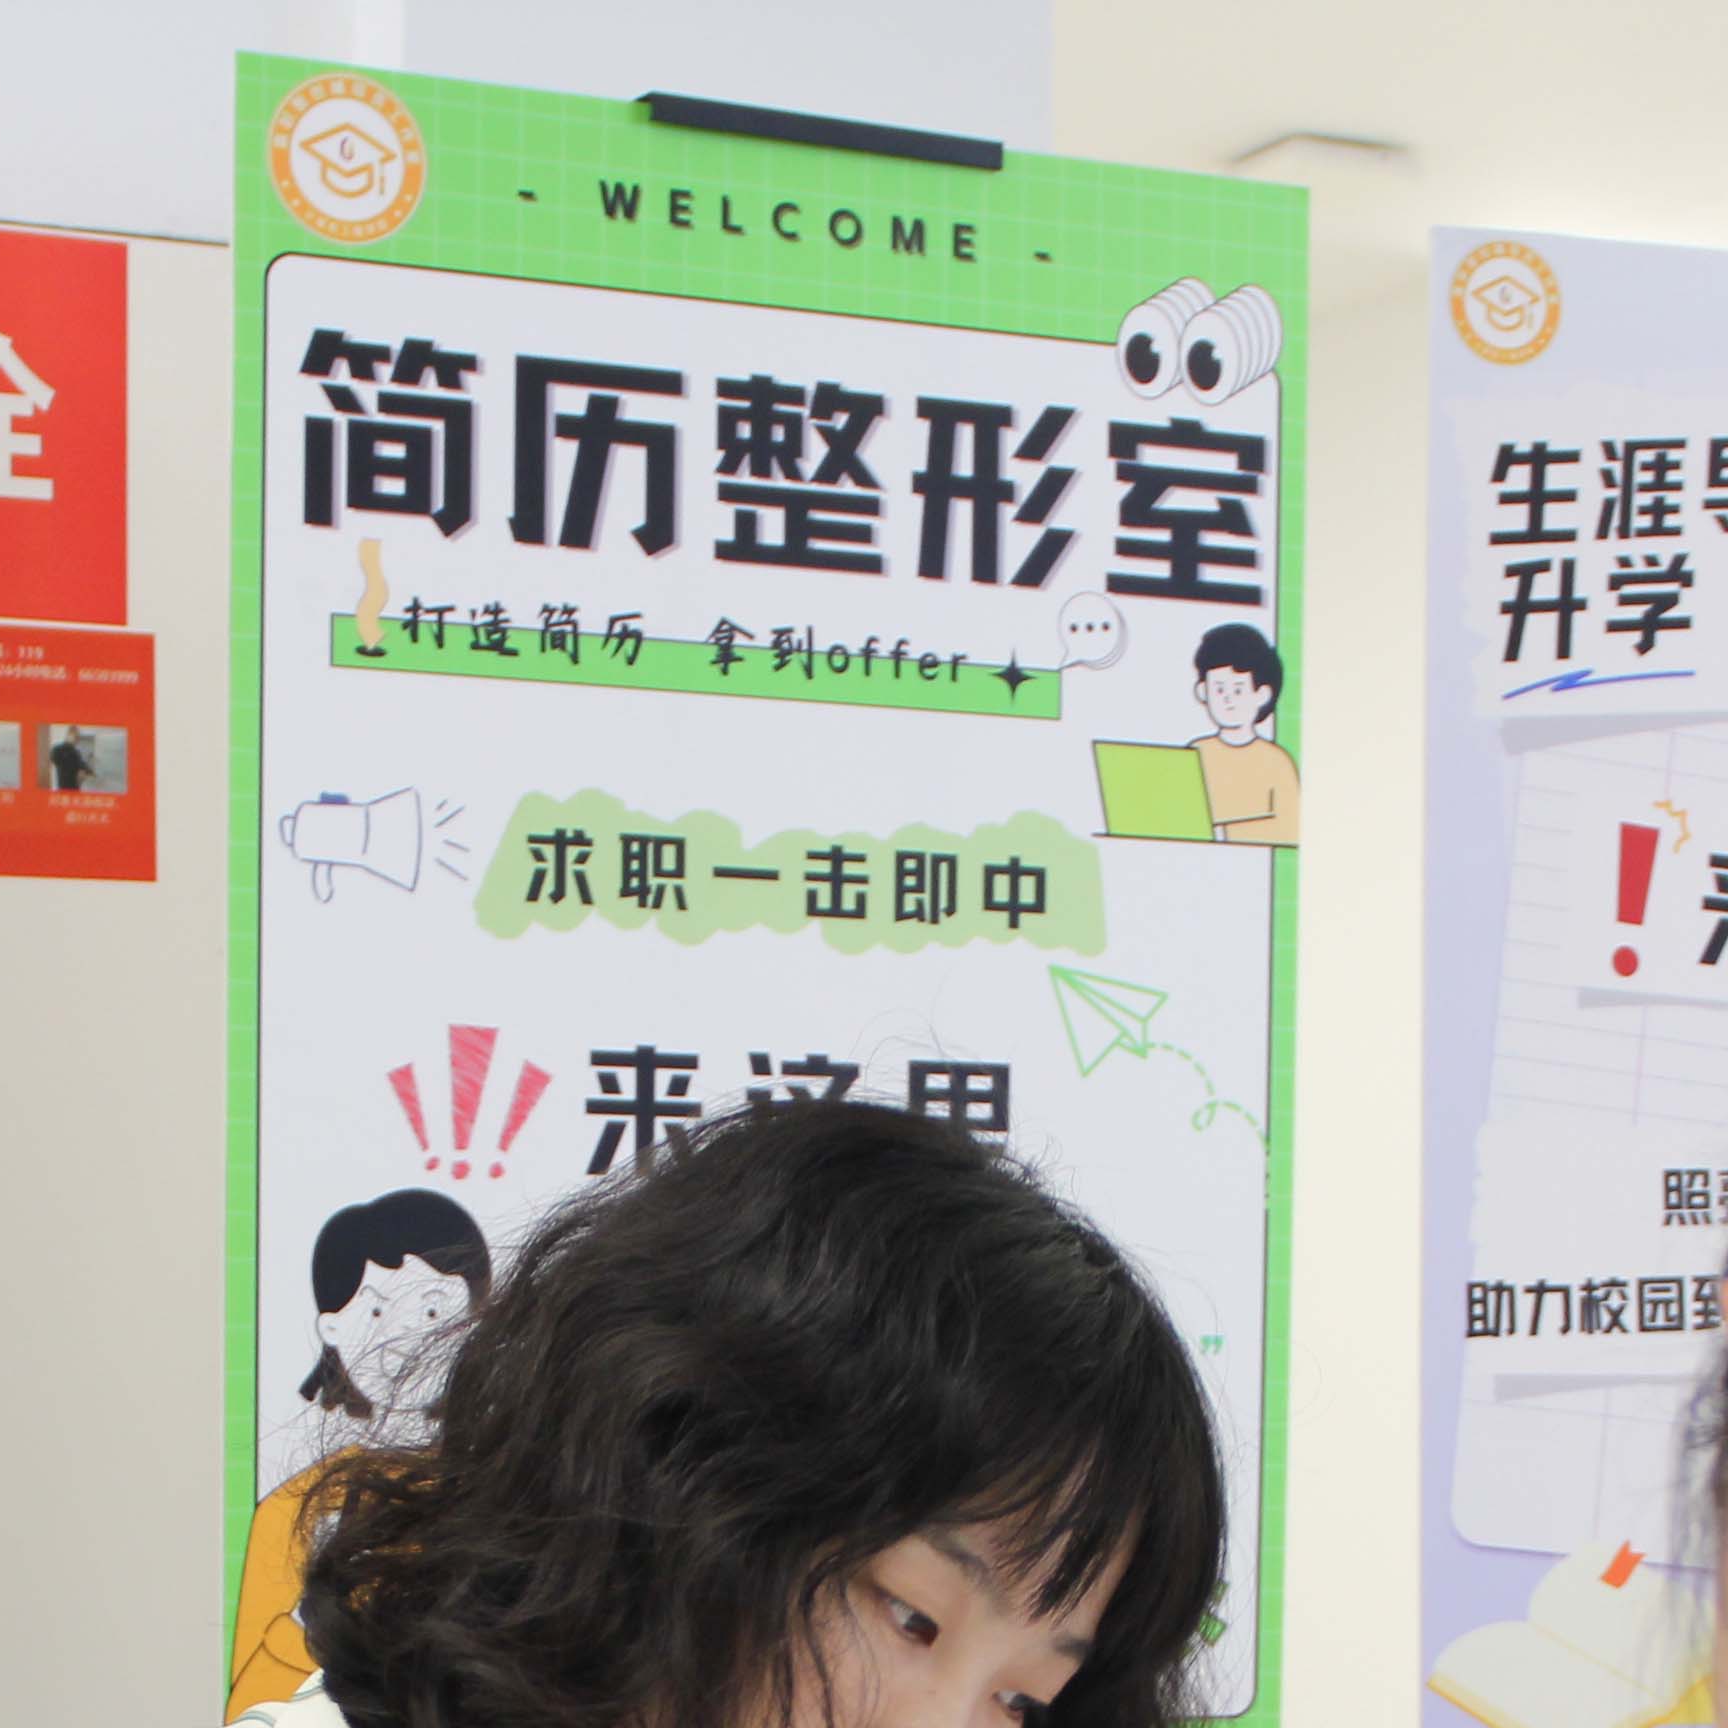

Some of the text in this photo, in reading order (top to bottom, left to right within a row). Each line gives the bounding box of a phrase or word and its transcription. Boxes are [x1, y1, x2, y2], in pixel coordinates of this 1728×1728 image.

[600, 180, 978, 261] WELCOME
[299, 327, 1272, 607] 简历整形室
[403, 596, 970, 683] 打造简历 拿到offer
[523, 826, 1049, 930] 求职一击即中
